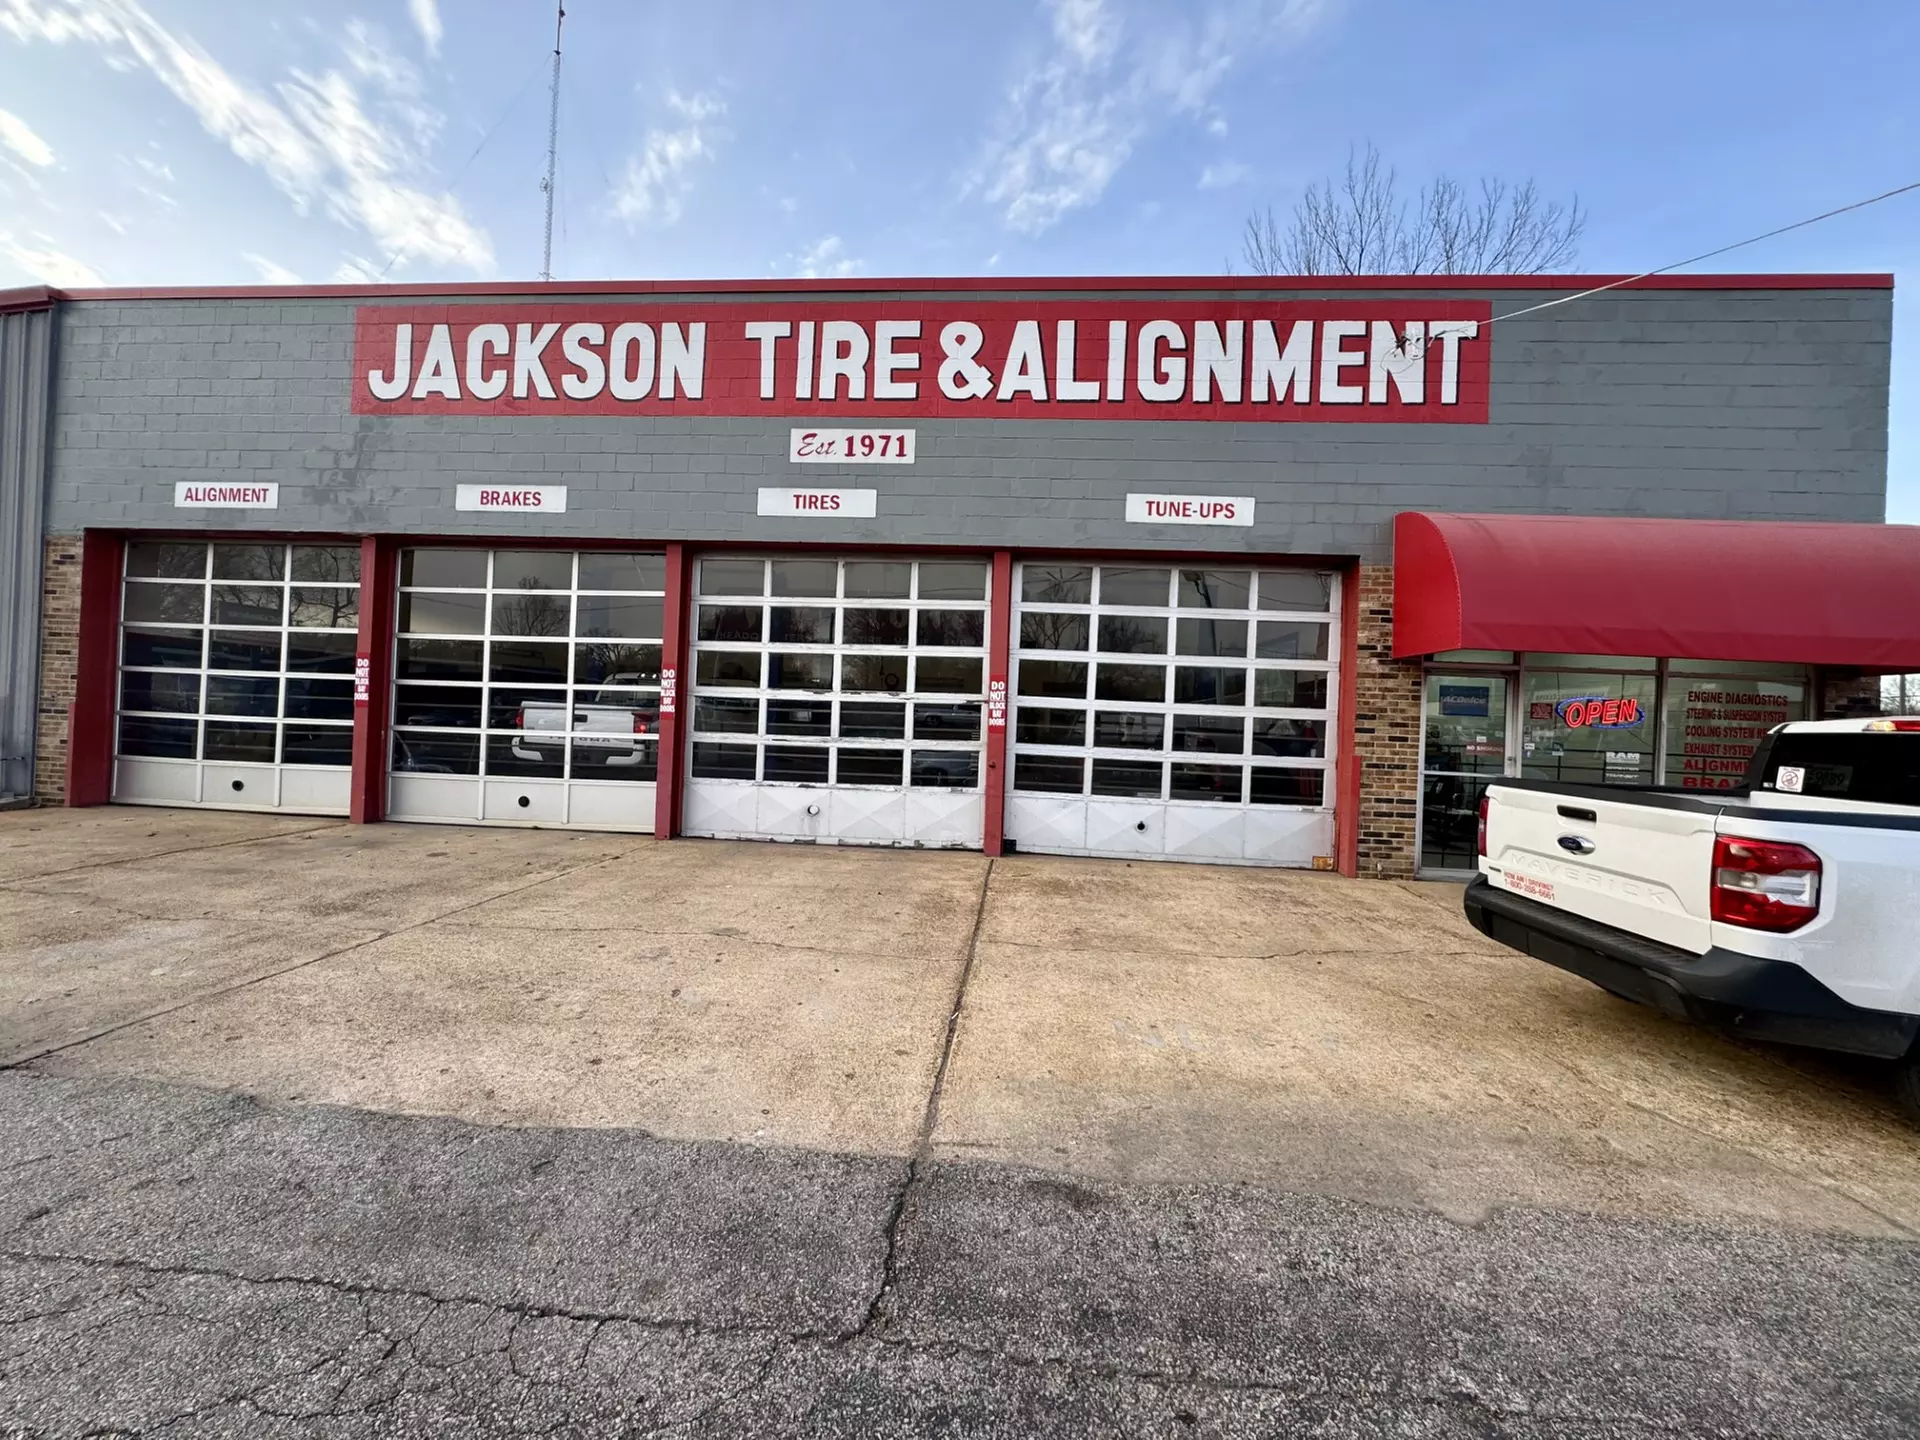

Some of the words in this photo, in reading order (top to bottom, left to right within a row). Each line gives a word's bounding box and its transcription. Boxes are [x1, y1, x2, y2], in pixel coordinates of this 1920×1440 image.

[367, 320, 706, 402] JACKSON
[744, 319, 921, 402] TIRE
[936, 319, 994, 401] &
[996, 318, 1479, 405] ALIGNMENT
[797, 432, 838, 457] Est.
[844, 434, 908, 458] 1971
[184, 487, 270, 503] ALIGNMENT
[480, 490, 542, 507] BRAKES
[793, 494, 841, 511] TIRES
[1145, 500, 1236, 519] TUNE-UPS
[357, 658, 369, 667] DO
[356, 667, 370, 677] NOT
[662, 669, 675, 678] DO
[661, 679, 676, 688] NOT
[991, 681, 1005, 690] DO
[990, 691, 1006, 700] NOT
[1688, 691, 1723, 704] ENGINE
[1725, 693, 1789, 707] DIAGNOSTICS
[1565, 698, 1638, 728] OPEN
[1686, 708, 1715, 720] STEERING
[1723, 709, 1762, 722] SUSPENSION
[1685, 725, 1721, 738] COOLING
[1722, 727, 1755, 739] SYSTEM
[1684, 743, 1720, 755] EXHAUST
